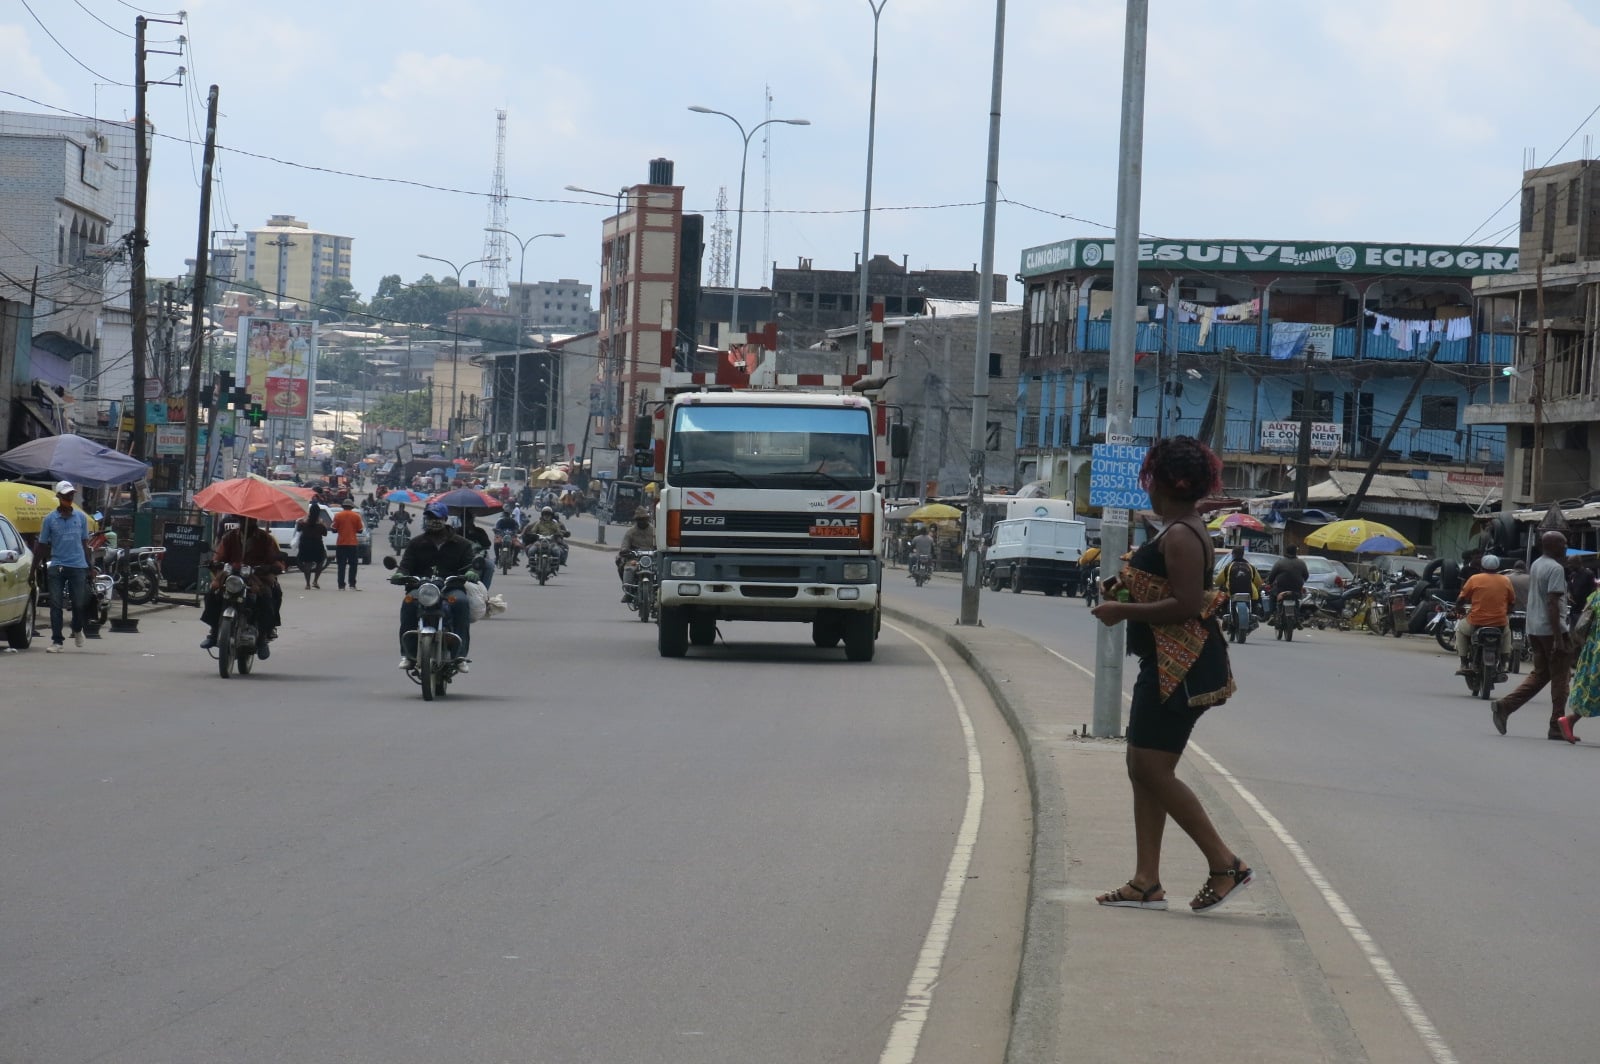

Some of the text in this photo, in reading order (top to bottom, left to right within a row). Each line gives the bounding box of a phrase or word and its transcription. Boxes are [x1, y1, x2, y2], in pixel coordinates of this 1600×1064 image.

[1026, 246, 1061, 269] CLINIQUE
[1293, 245, 1337, 266] SCANNER
[1278, 431, 1341, 441] CONNENT
[815, 518, 858, 527] DAF
